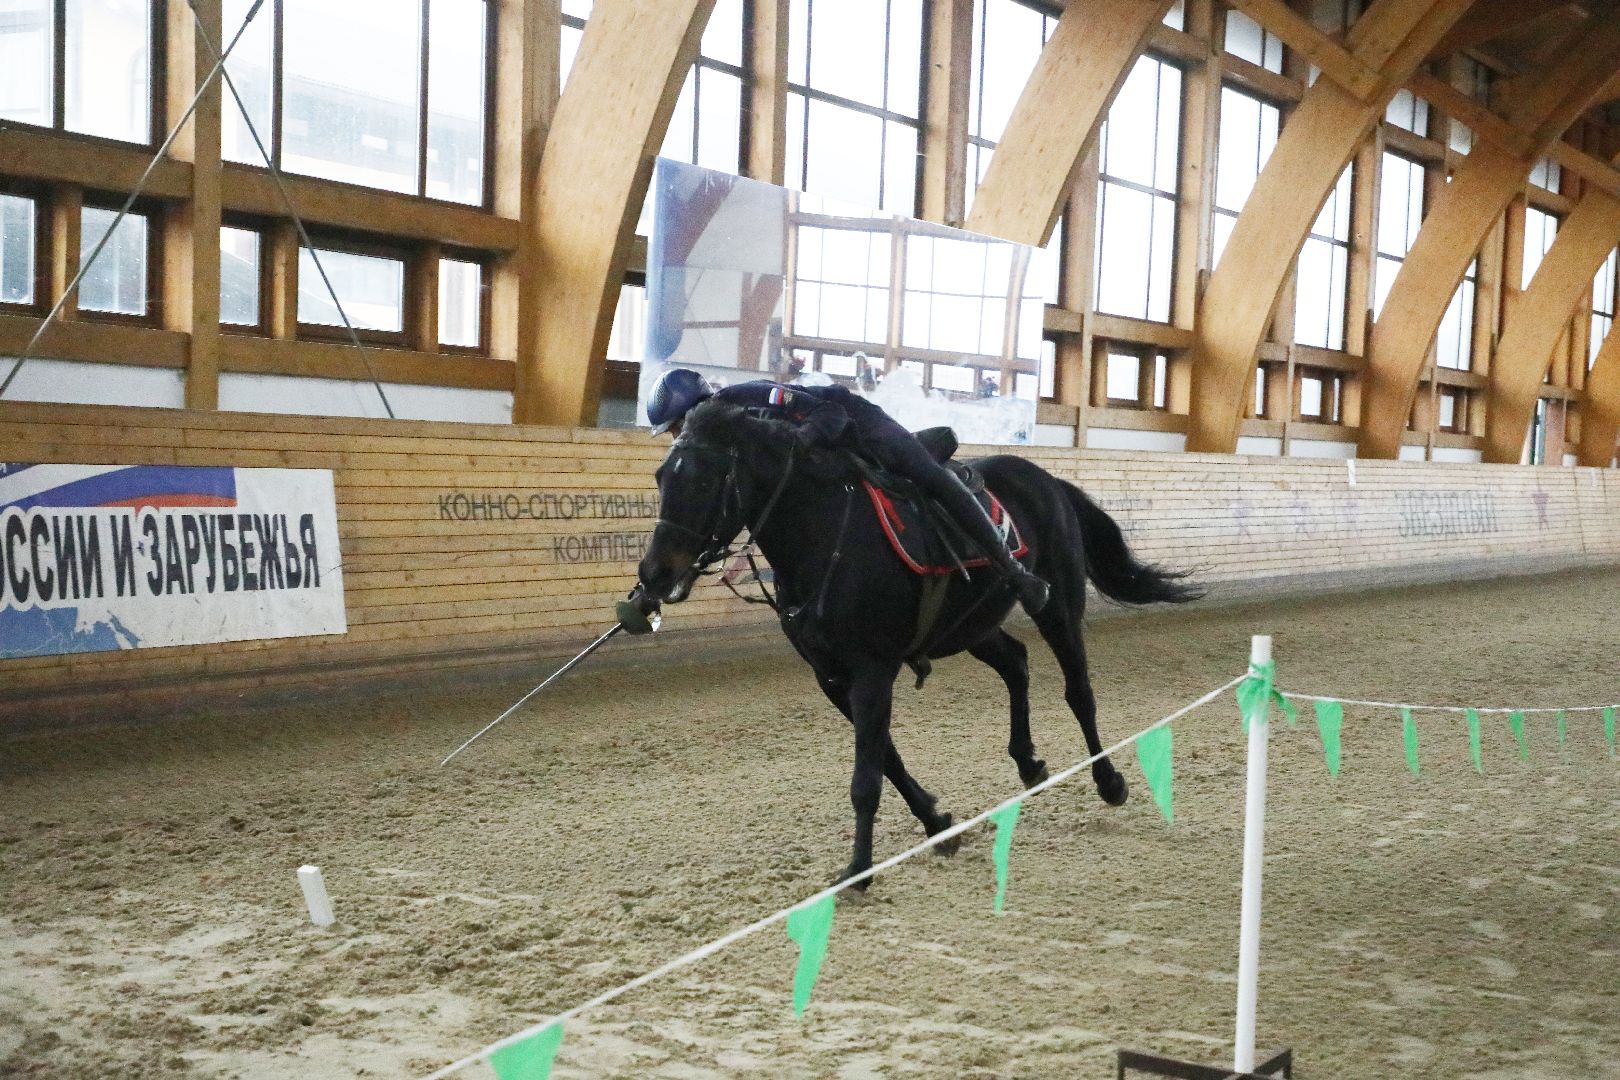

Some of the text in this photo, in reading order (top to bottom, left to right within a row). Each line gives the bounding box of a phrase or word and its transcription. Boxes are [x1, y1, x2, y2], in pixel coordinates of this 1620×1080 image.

[439, 492, 660, 520] КОННО-СПОРТИВНЫ
[0, 513, 321, 603] ССИИ И ЗАРУБЕЖЬЯ
[553, 533, 649, 561] КОМПЛЕК
